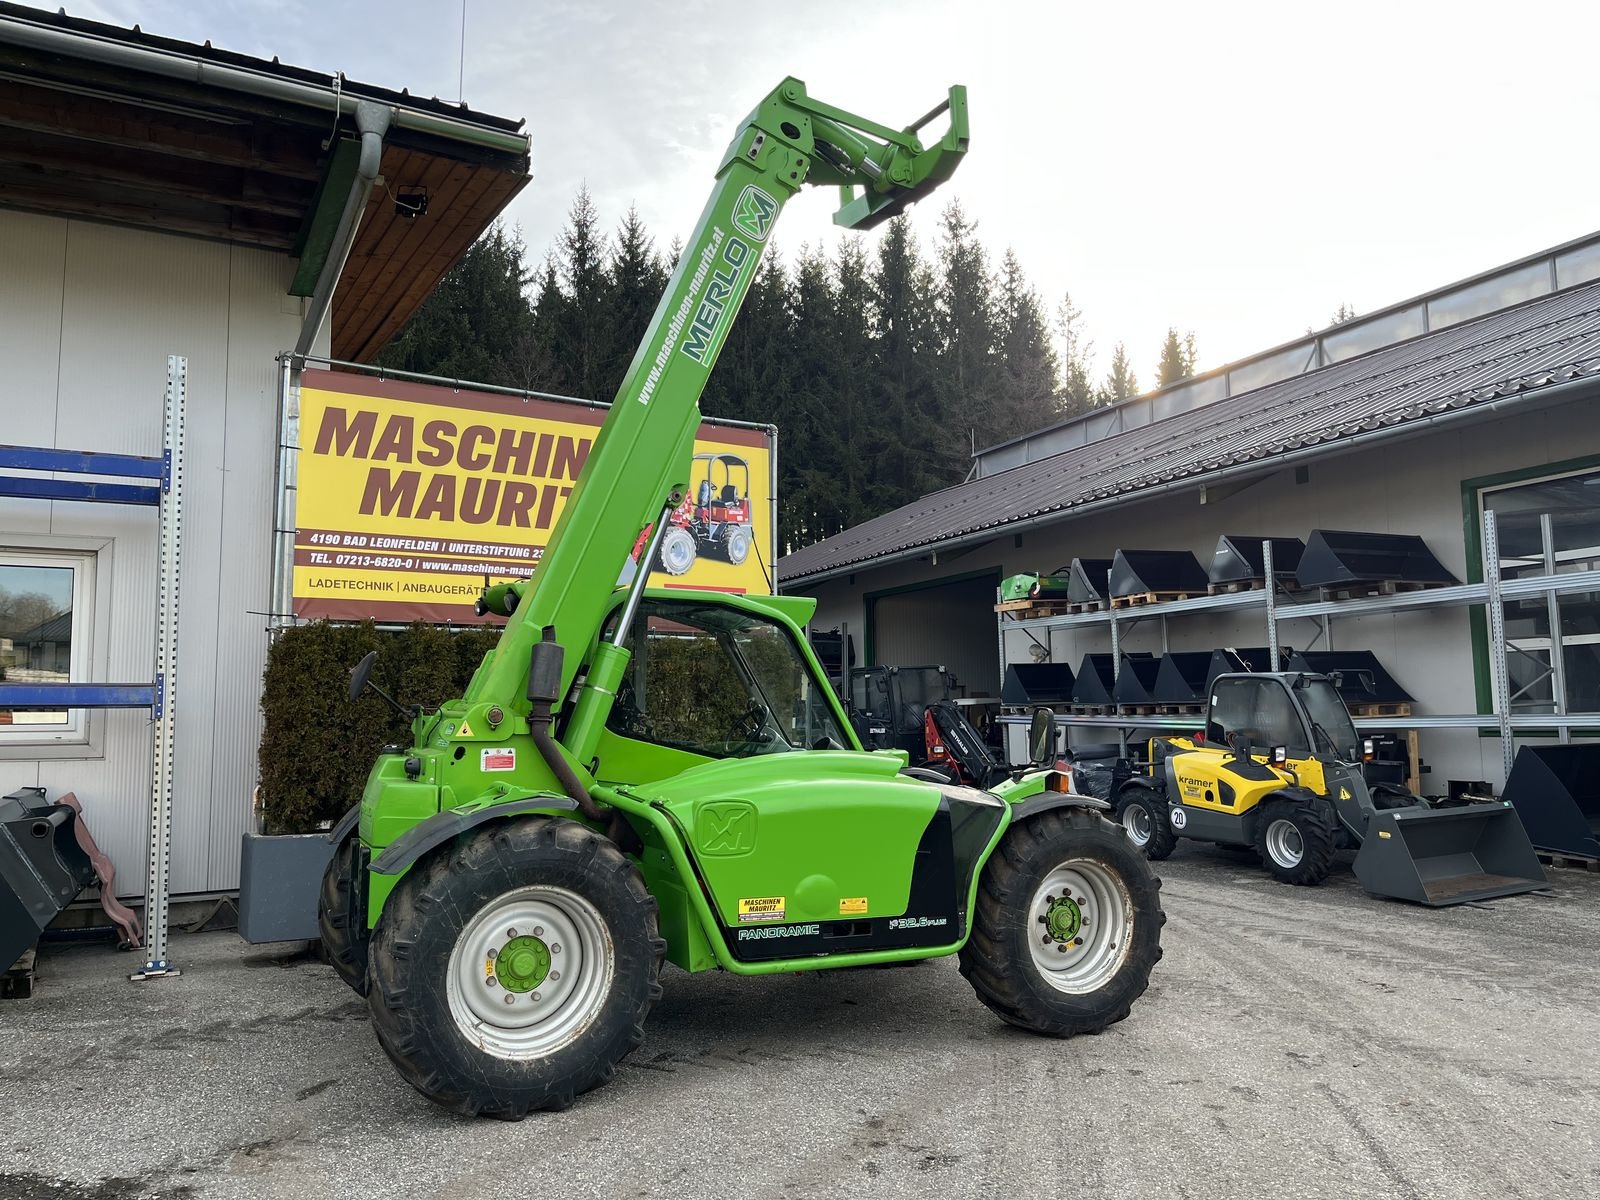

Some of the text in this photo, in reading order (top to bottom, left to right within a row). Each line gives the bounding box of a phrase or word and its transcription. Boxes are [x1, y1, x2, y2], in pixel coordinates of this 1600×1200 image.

[680, 236, 750, 363] MERLO
[637, 225, 725, 406] www.maschinen-mauritz.at
[313, 406, 593, 481] MASCHIN
[310, 533, 340, 545] 4190
[343, 535, 367, 547] BAD
[370, 537, 439, 552] LEONFELDEN
[448, 543, 530, 558] UNTERSTIFTUNG
[310, 552, 536, 576] TEL. 07213-6820-0 www.maschinen-maur
[309, 578, 483, 595] LADETECHNIK ANBAUGERÄT
[1178, 775, 1214, 788] kramer
[1174, 811, 1184, 825] 20
[744, 898, 781, 906] MASCHINEN
[749, 904, 777, 912] MAURITZ
[738, 924, 820, 941] PANORAMIC
